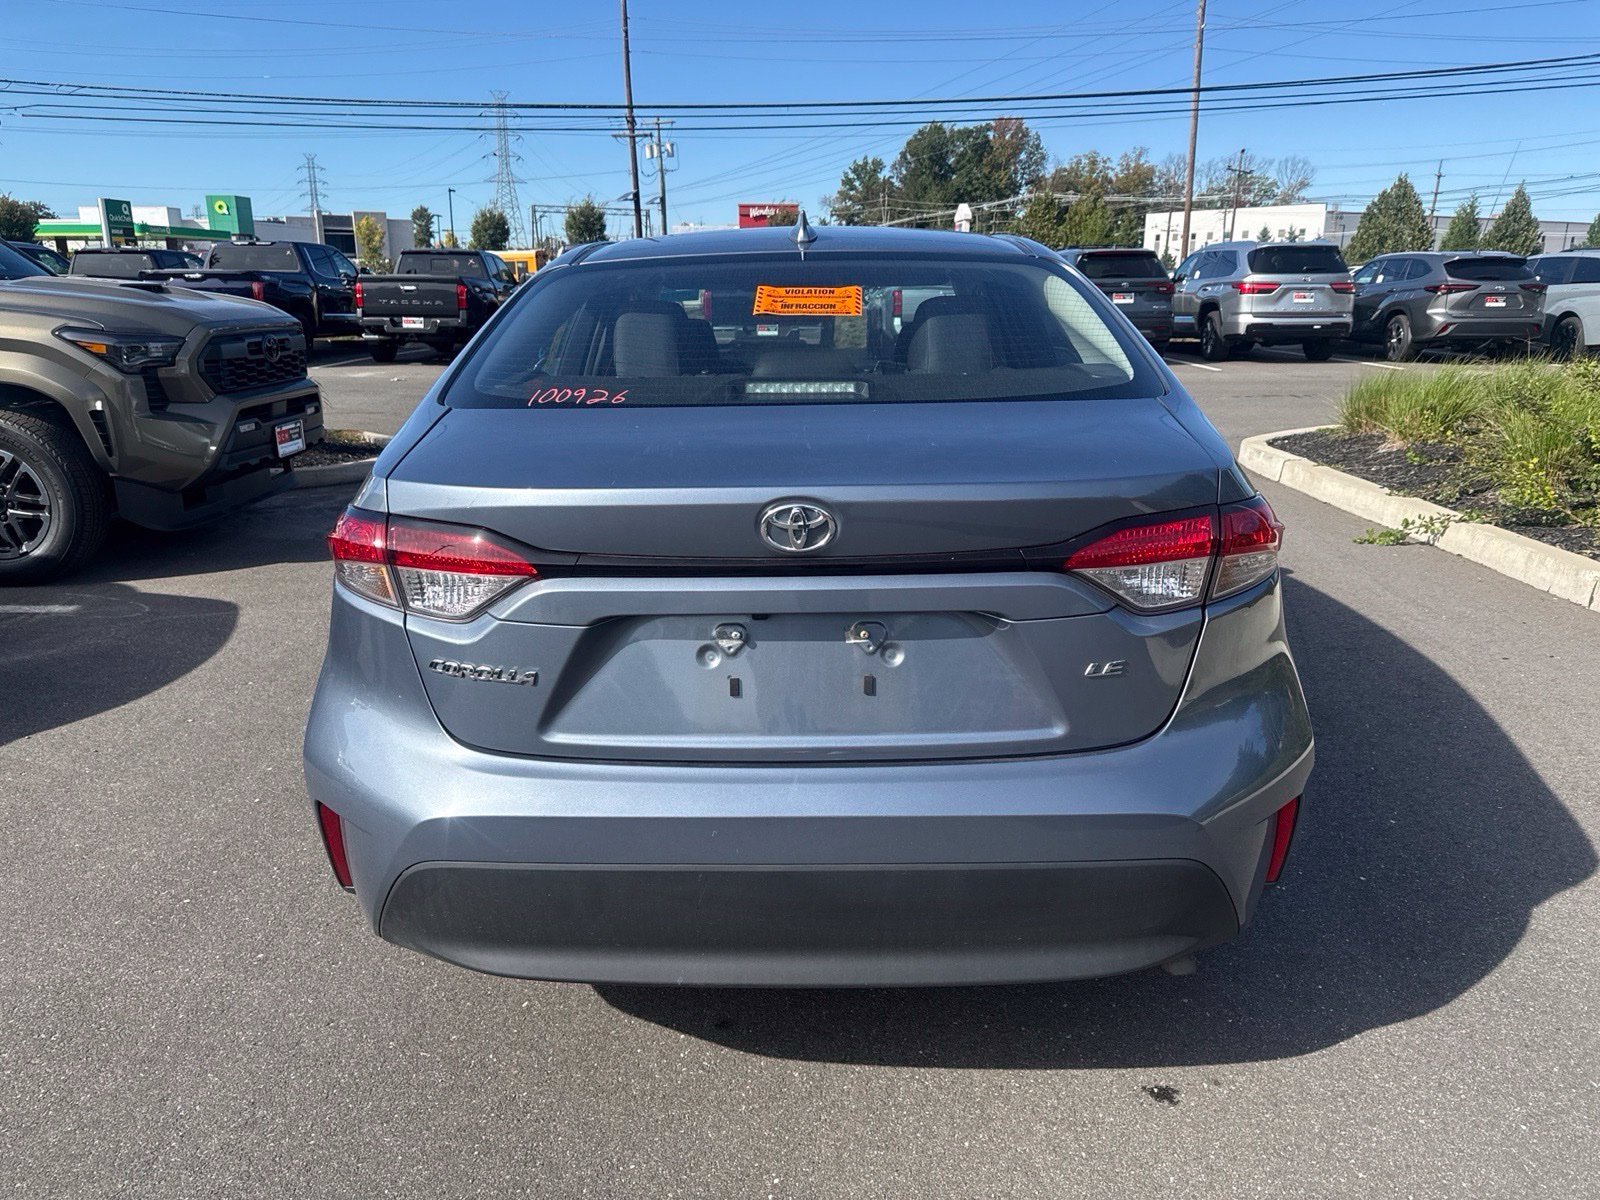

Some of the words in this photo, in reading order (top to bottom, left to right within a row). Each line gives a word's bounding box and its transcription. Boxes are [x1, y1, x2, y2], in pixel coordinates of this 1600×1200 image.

[527, 388, 629, 406] 100926
[429, 658, 539, 687] COROLLA
[1084, 660, 1126, 677] LE
